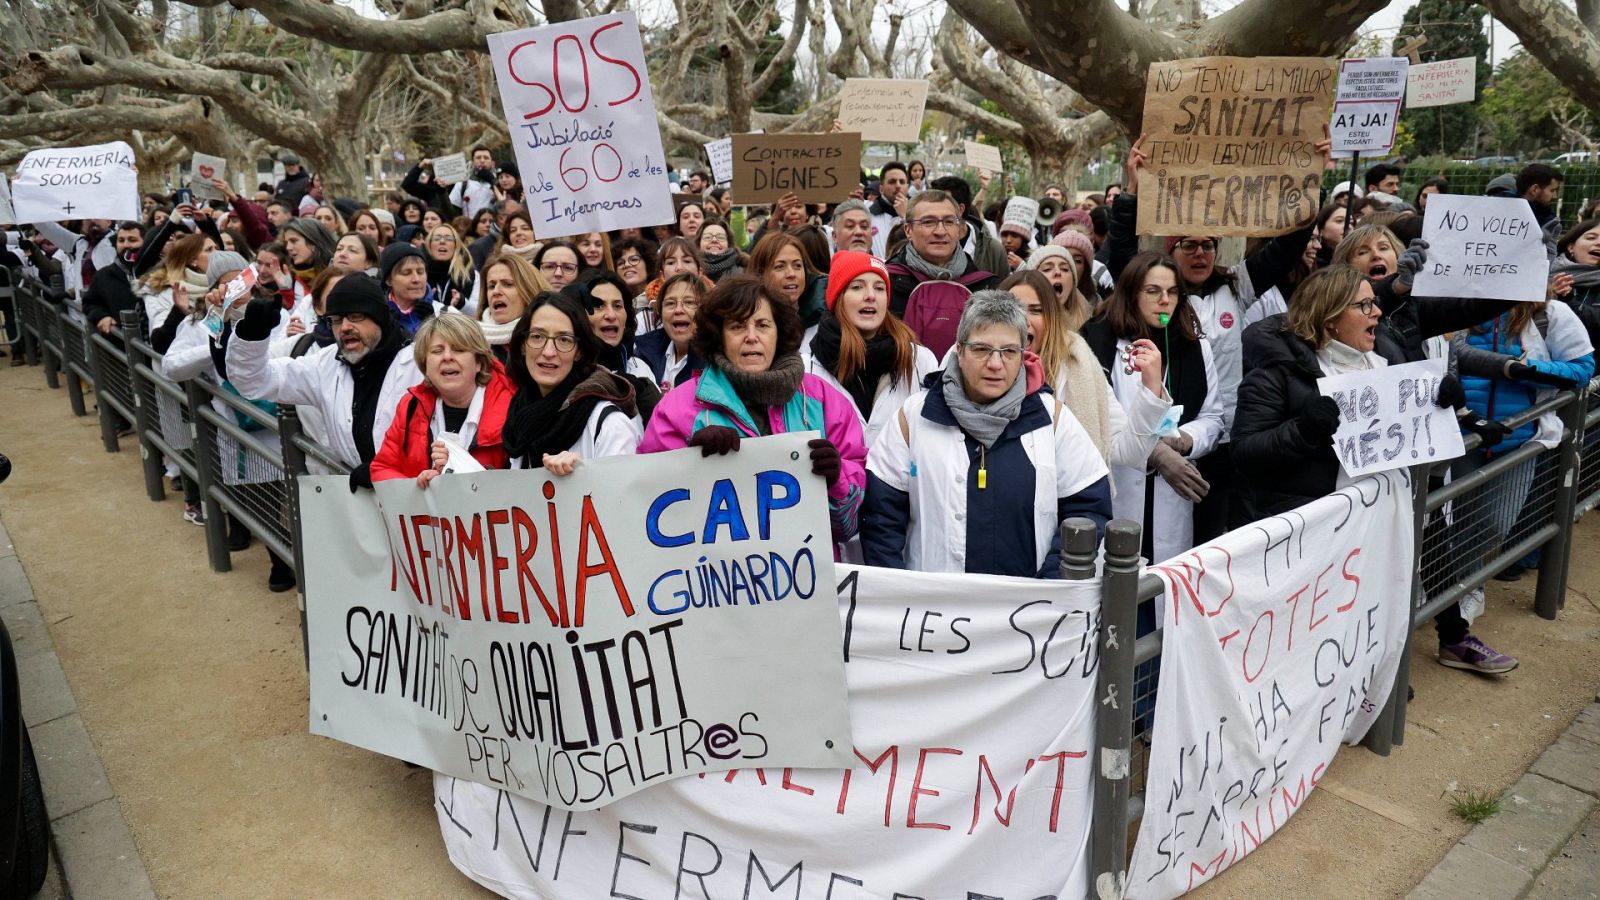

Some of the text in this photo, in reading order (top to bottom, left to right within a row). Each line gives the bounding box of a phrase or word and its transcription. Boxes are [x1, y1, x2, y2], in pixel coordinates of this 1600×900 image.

[508, 21, 643, 119] S.O.S.
[1156, 68, 1183, 93] NO
[1255, 67, 1274, 93] LA
[521, 118, 615, 149] Jubilació
[1335, 112, 1388, 128] A1 JA!
[22, 151, 131, 169] ENFERMERIA
[529, 143, 663, 194] als 60 de les
[743, 147, 842, 162] CONTRACTES
[40, 171, 102, 187] SOMOS
[542, 196, 643, 222] Infermeres
[1439, 209, 1530, 240] NO VOLEM
[1464, 242, 1498, 257] FER
[1433, 263, 1519, 276] DE METGES
[1332, 385, 1379, 424] NO
[646, 470, 801, 548] CAP
[899, 607, 971, 654] LES
[1314, 601, 1379, 688] QUE
